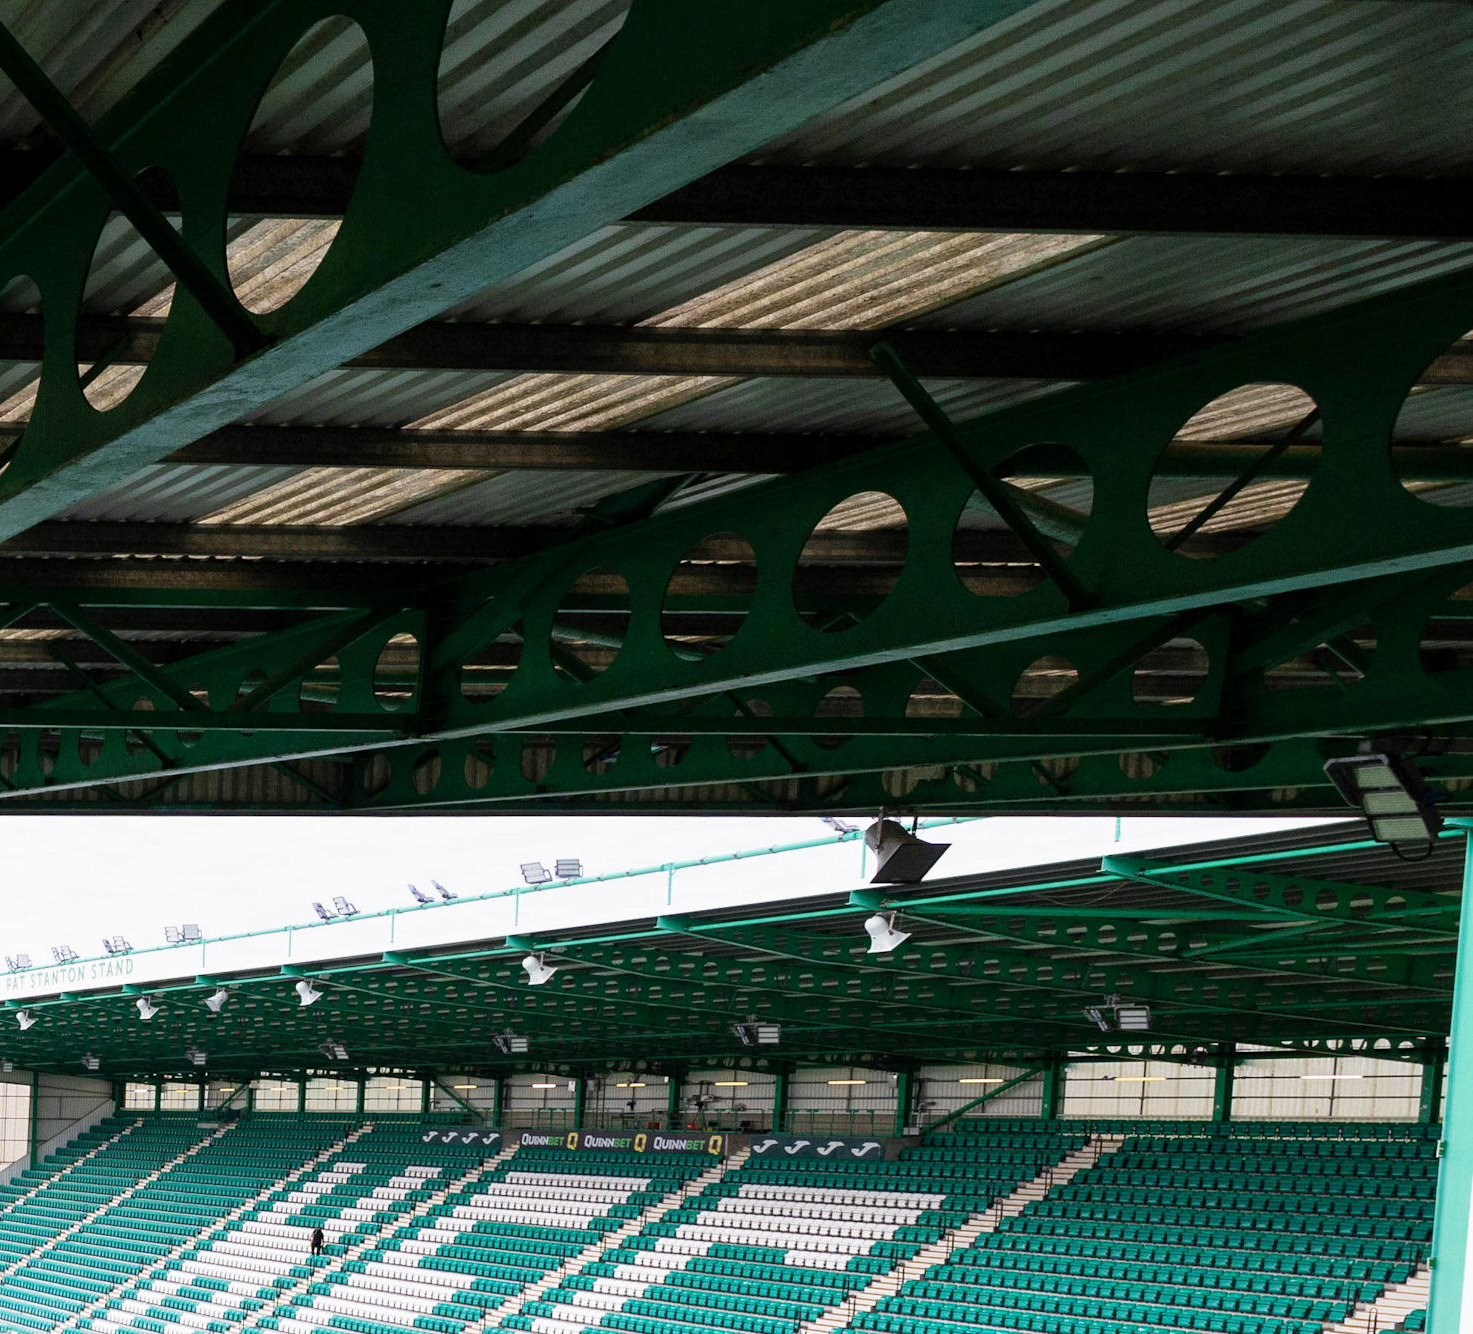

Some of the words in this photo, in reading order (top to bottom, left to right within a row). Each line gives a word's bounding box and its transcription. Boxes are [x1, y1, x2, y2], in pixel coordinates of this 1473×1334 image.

[521, 1133, 564, 1147] QUINNBET
[584, 1135, 631, 1149] QUINNBET
[653, 1136, 706, 1151] QUINNBET
